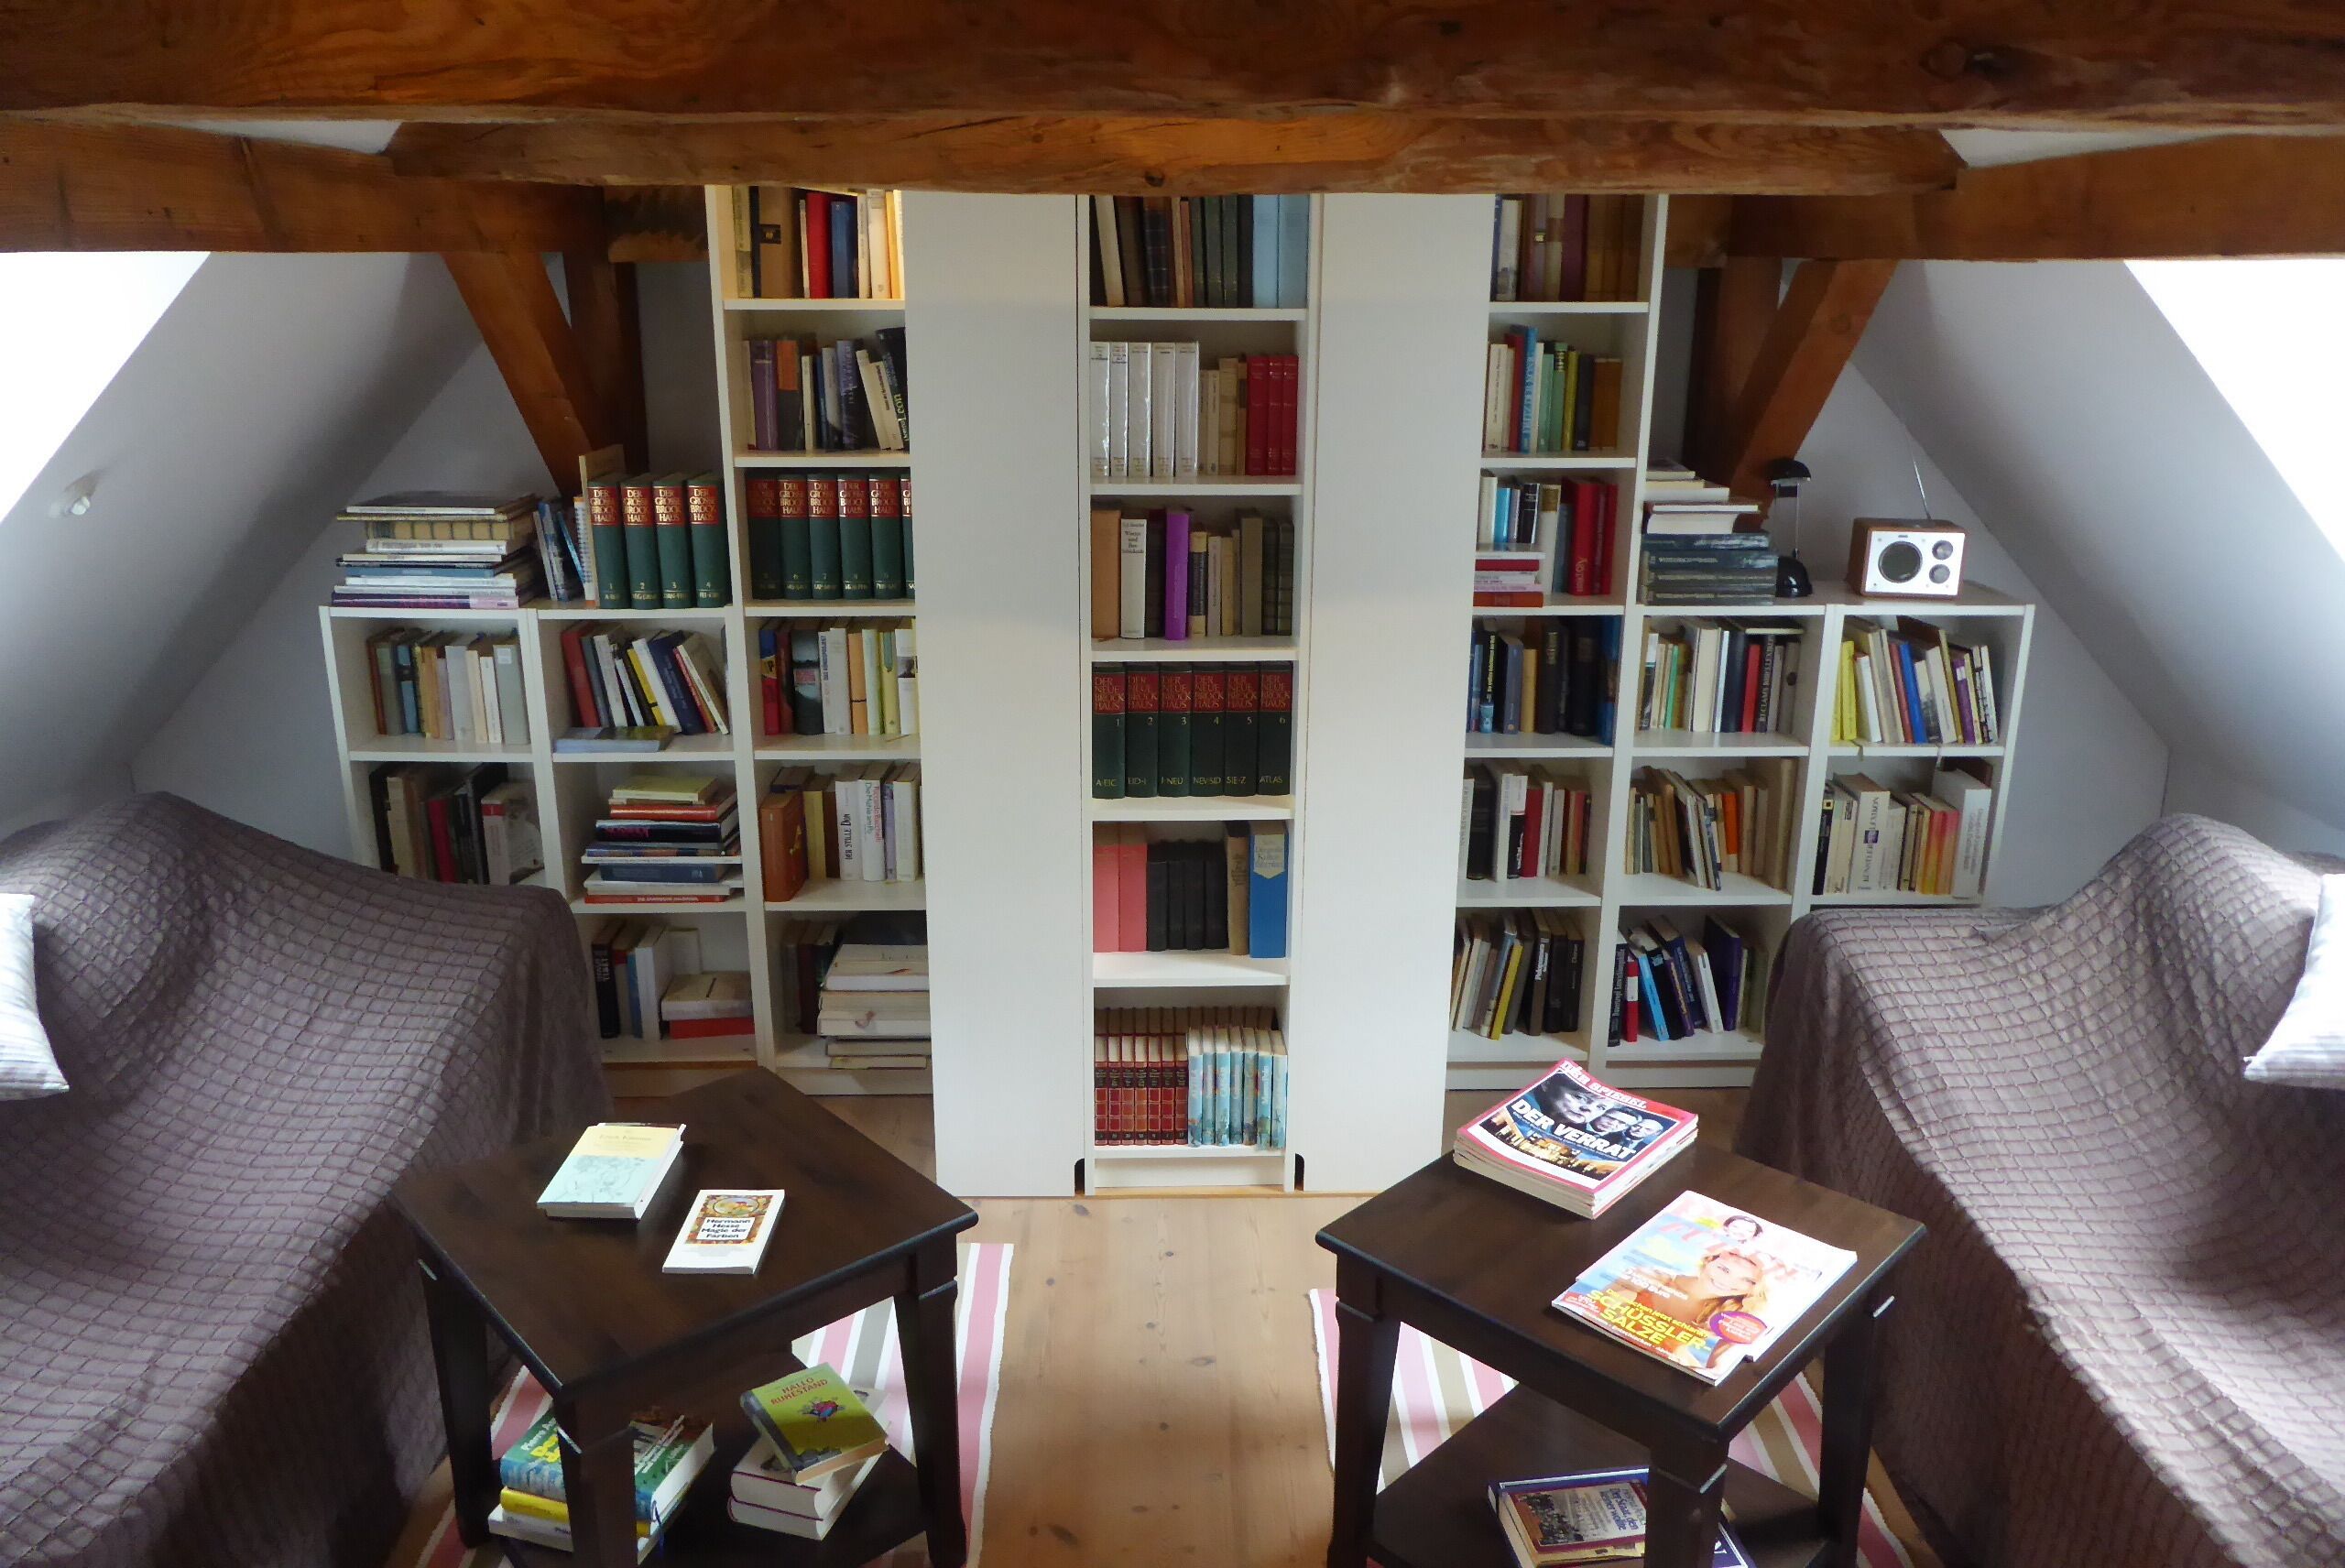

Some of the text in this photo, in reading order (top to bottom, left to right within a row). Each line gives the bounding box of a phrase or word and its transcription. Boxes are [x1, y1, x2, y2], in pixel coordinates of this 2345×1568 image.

[844, 829, 853, 848] STILLE
[1560, 1060, 1647, 1108] DER SPIEGEL
[1511, 1099, 1636, 1159] DER VERRAT
[1587, 1290, 1711, 1350] SCHÜSSLER-
[1599, 1309, 1667, 1345] SALZE
[770, 1378, 828, 1406] RUHESTAND
[781, 1377, 814, 1394] HALLO
